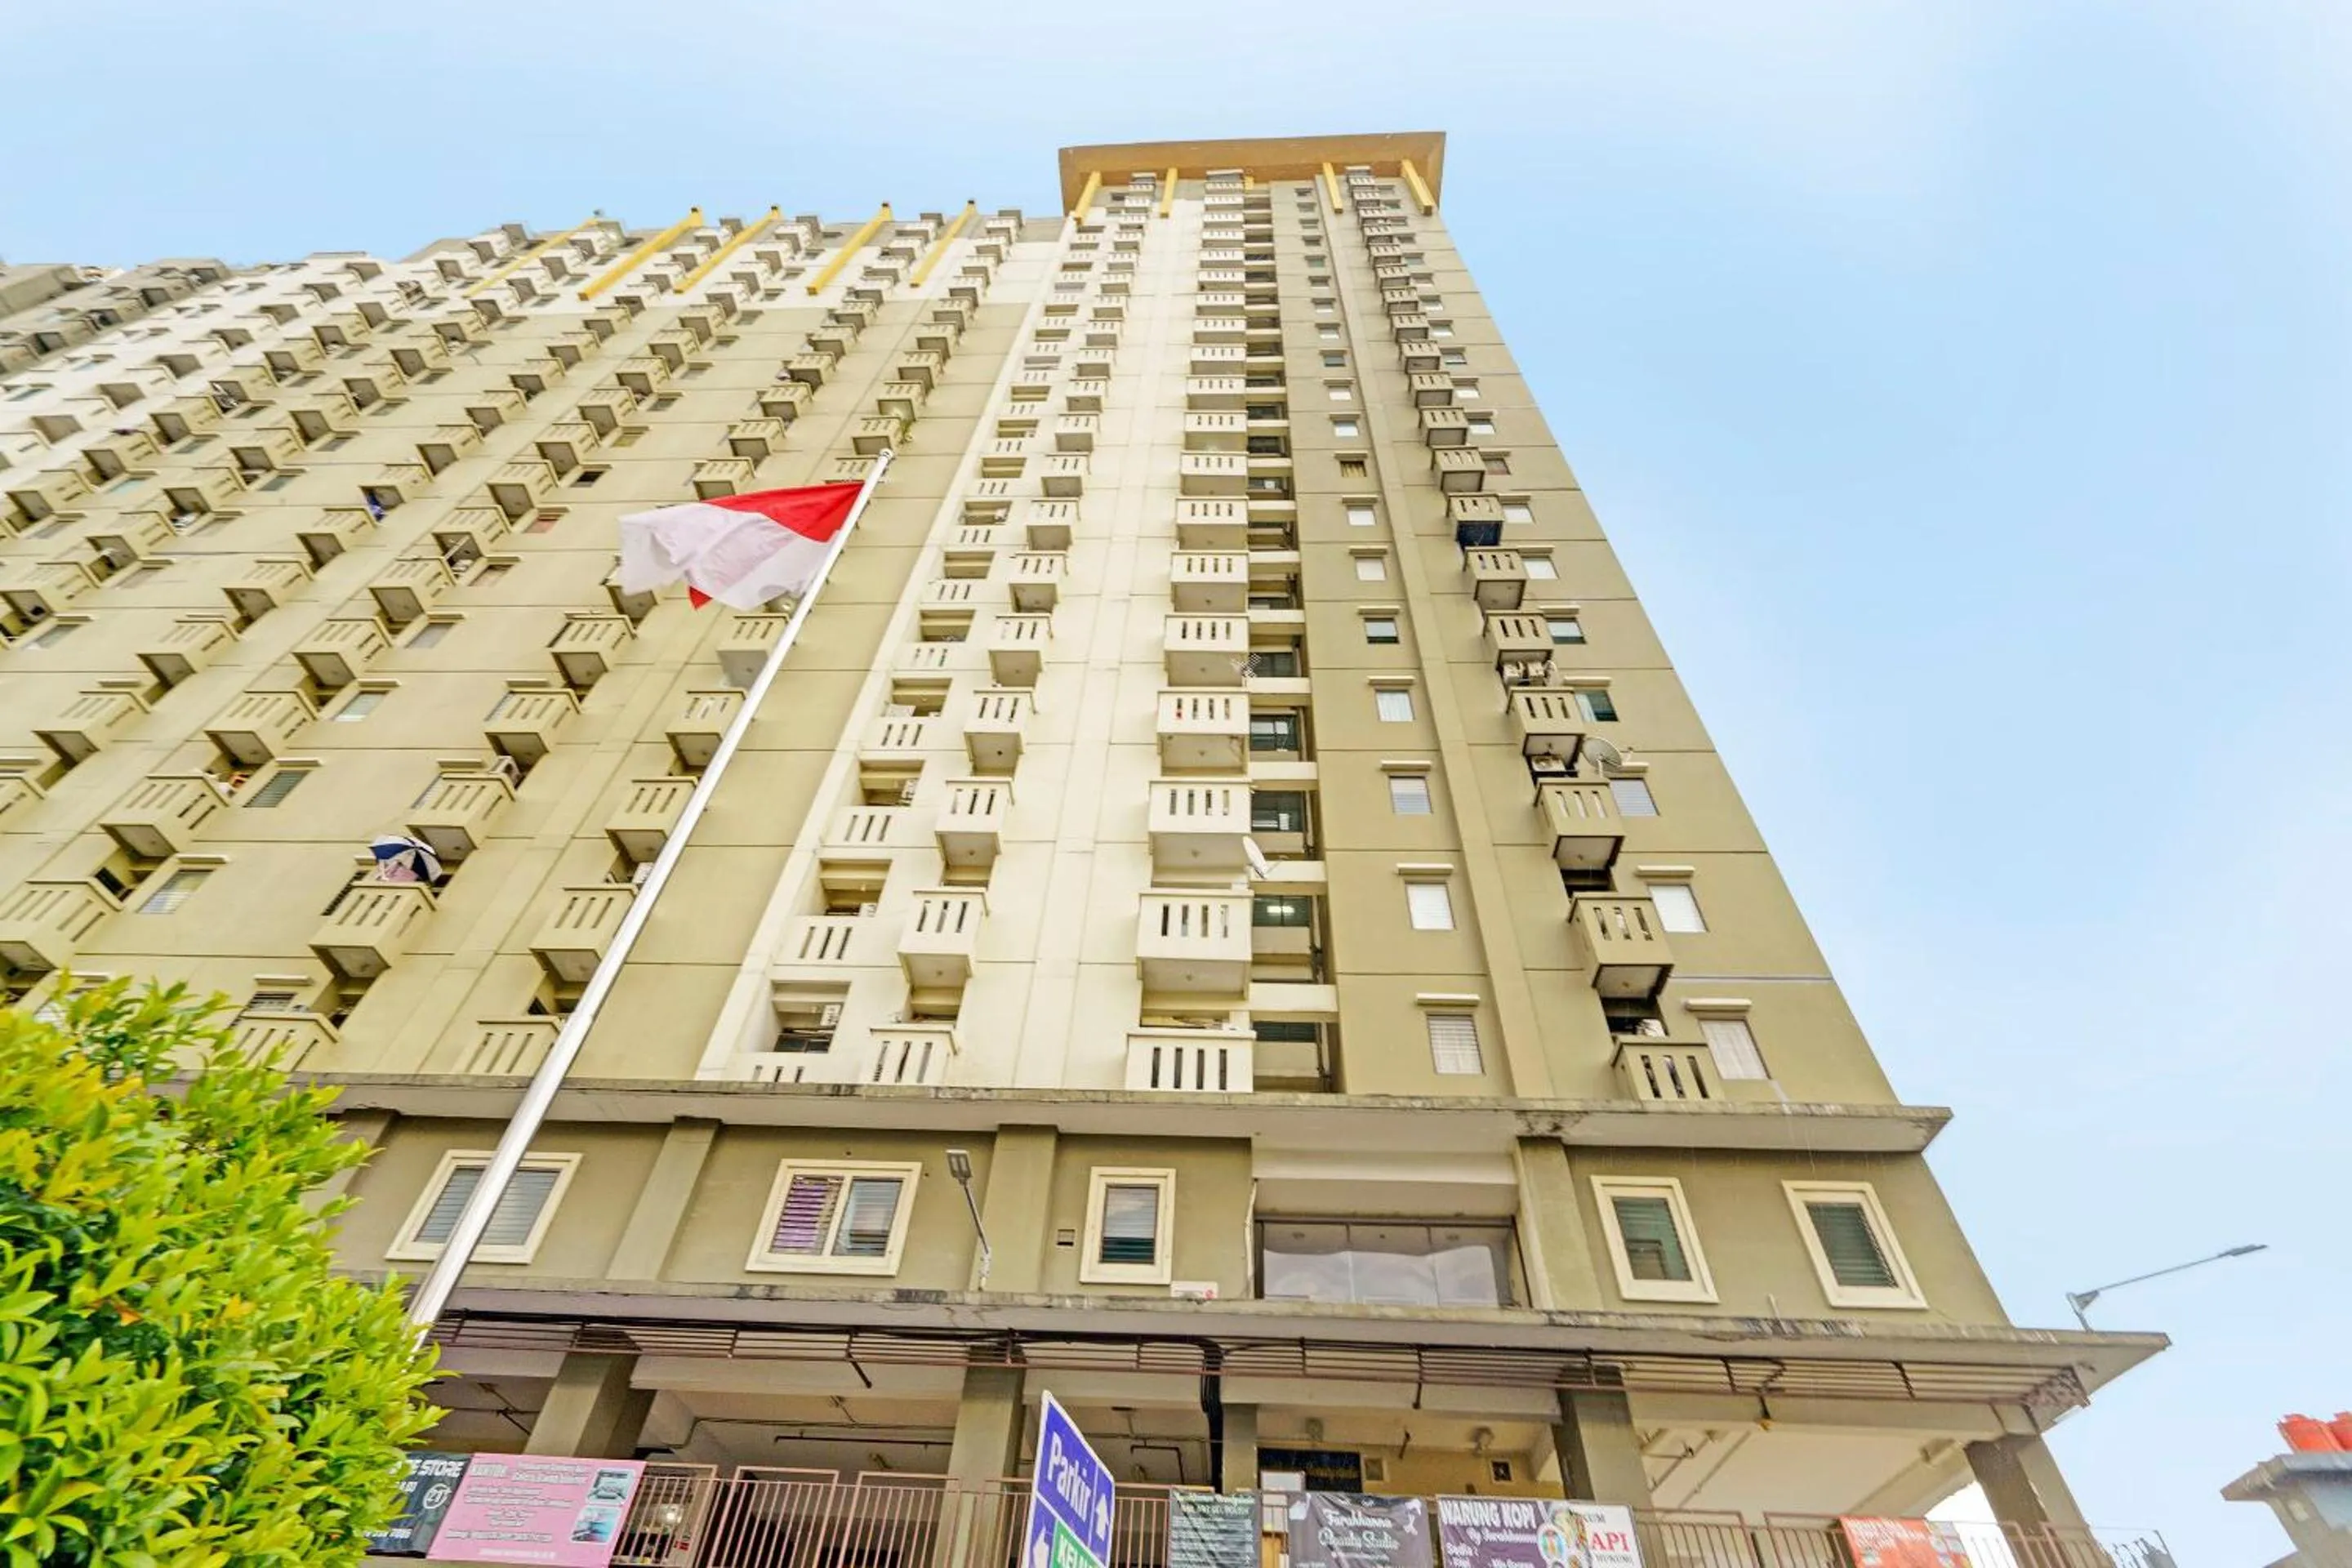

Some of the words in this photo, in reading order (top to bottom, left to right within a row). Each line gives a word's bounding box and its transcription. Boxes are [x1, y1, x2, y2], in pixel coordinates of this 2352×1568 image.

[417, 1459, 465, 1478] STORE
[1048, 1431, 1092, 1523] Parkir
[1438, 1499, 1501, 1528] WARUNG
[1501, 1502, 1536, 1529] KOPI
[1591, 1531, 1630, 1552] API
